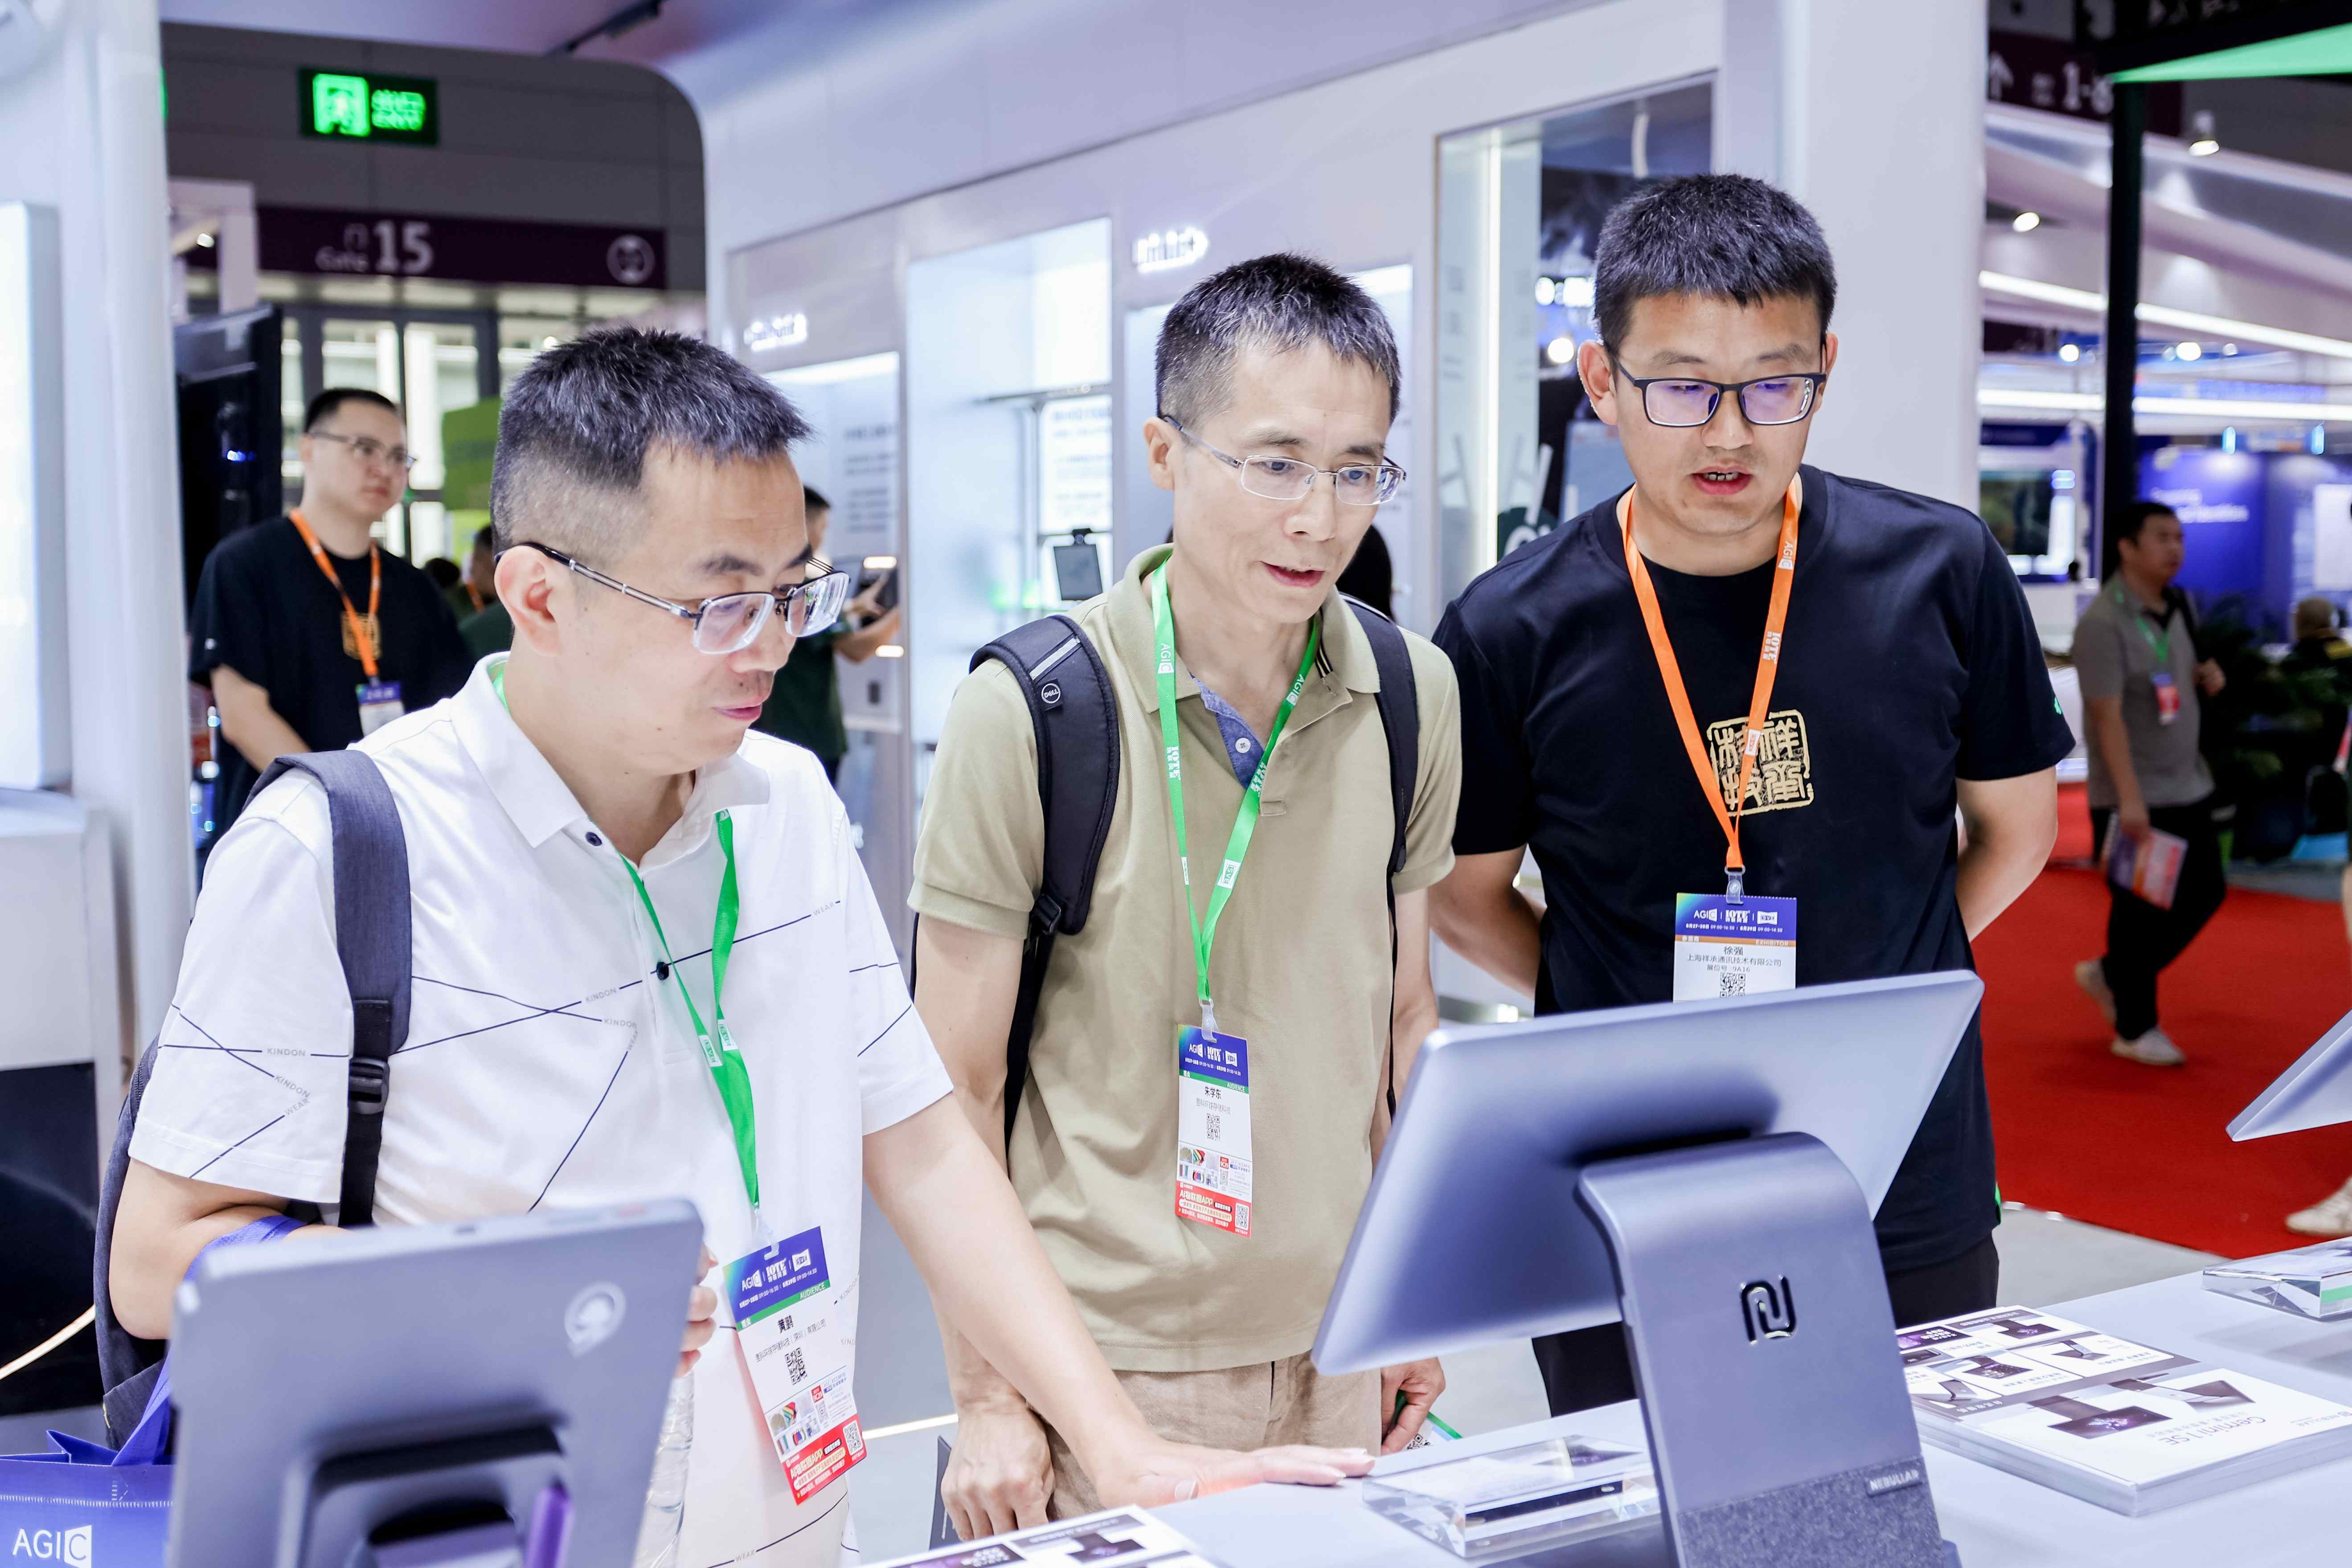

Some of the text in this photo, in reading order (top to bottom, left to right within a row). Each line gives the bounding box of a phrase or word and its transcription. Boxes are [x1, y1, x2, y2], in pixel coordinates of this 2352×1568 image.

[373, 220, 434, 275] 15
[1778, 541, 1794, 570] AGIC
[1770, 632, 1782, 663] IOTE
[1158, 643, 1174, 674] AGIC
[1044, 688, 1059, 698] DELL
[1286, 674, 1305, 706] AGIC
[1171, 746, 1181, 779] IOTE
[813, 902, 835, 916] WEAR
[1693, 909, 1717, 922] AGIC
[1725, 910, 1749, 919] IOTE
[585, 987, 617, 1003] KINDON
[604, 1019, 637, 1029] KINDON
[267, 1047, 306, 1057] KINDON
[1189, 1043, 1203, 1058] AGIC
[1207, 1046, 1221, 1056] IOTE
[275, 1074, 310, 1098] KINDON
[1205, 1085, 1222, 1100] 朱学东
[1227, 1082, 1245, 1092] AUDIENCE
[284, 1097, 309, 1116] WEAR
[766, 1260, 787, 1277] IOTE
[742, 1269, 763, 1292] AGIC
[800, 1282, 826, 1300] AUDIENCE
[2197, 1416, 2266, 1437] Gemini
[2158, 1434, 2190, 1446] SE
[12, 1524, 92, 1568] AGIC
[735, 1549, 757, 1562] WEAR
